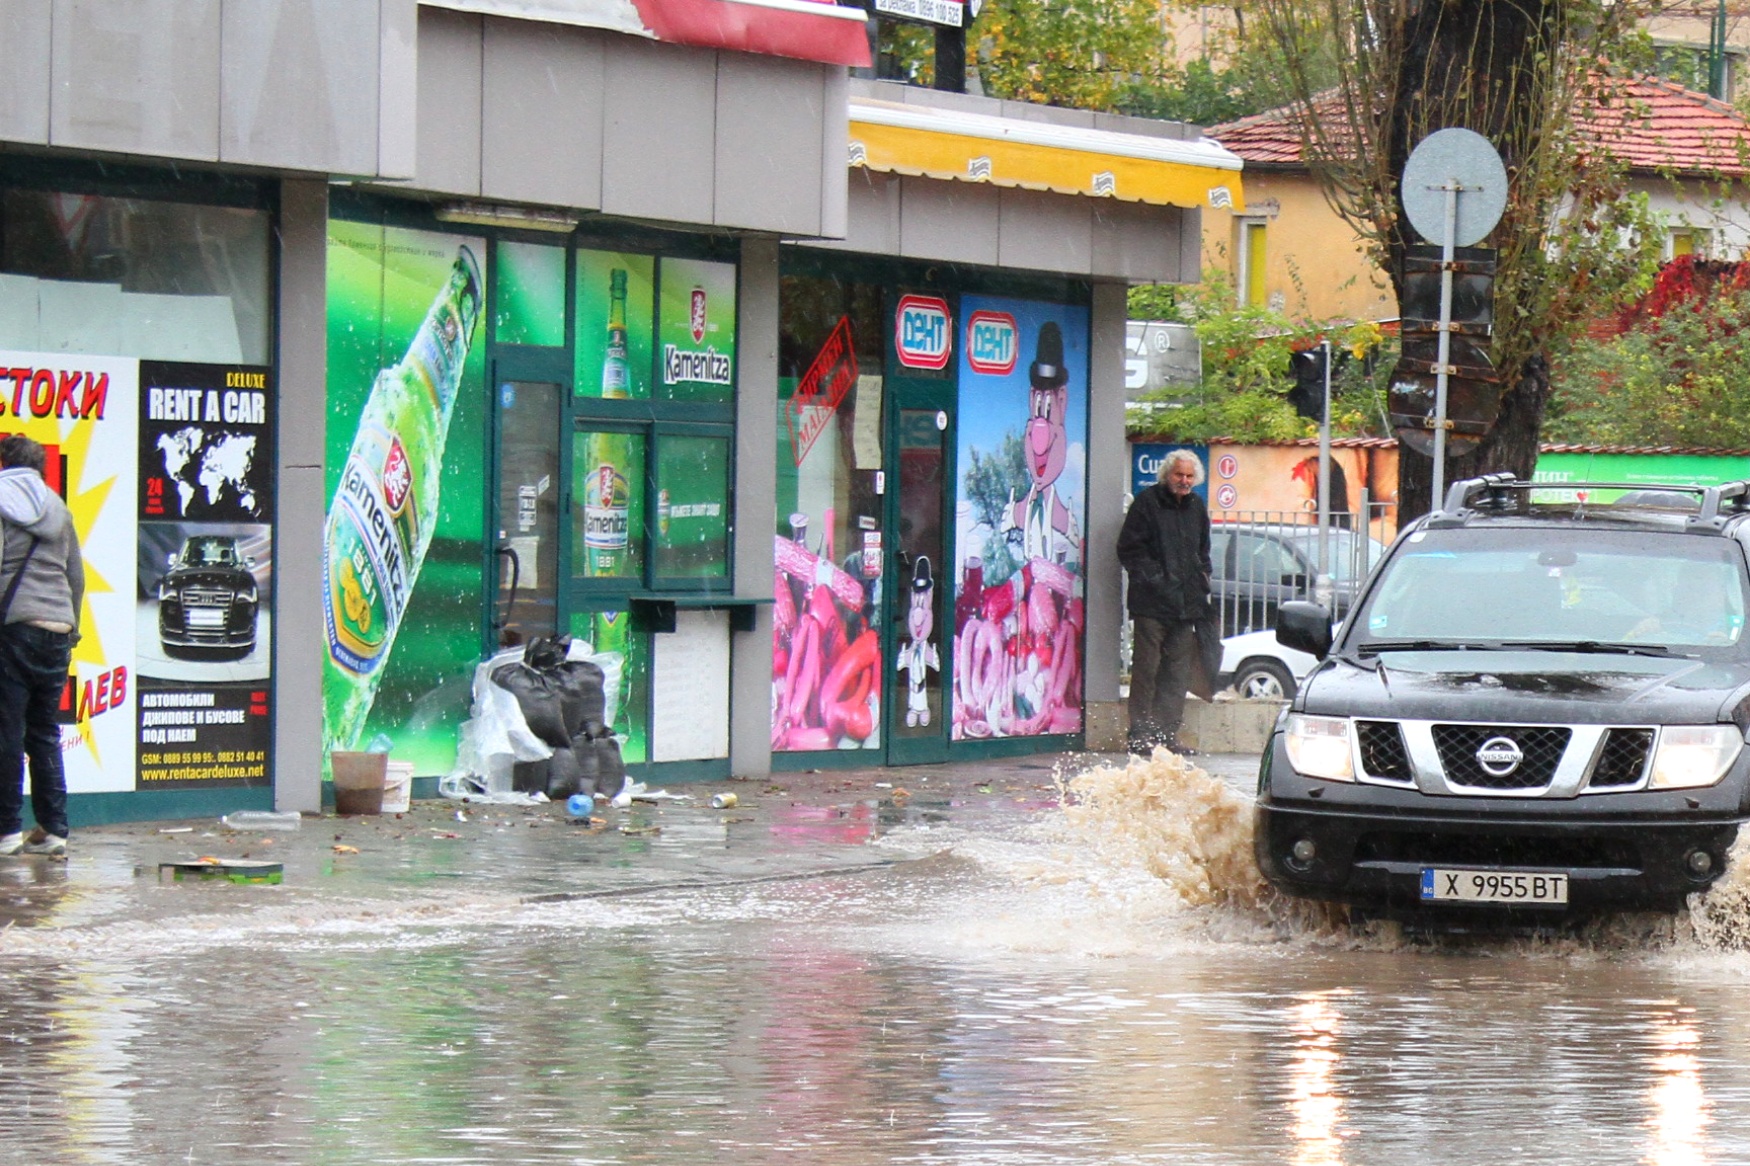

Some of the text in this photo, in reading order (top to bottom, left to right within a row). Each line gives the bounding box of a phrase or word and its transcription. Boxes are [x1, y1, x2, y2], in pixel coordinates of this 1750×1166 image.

[664, 344, 731, 384] Kamenitza
[226, 372, 266, 389] DELUXE
[149, 388, 266, 424] RENT A CAR
[147, 477, 163, 496] 24
[596, 556, 615, 567] 1881
[347, 538, 377, 607] 1881
[77, 665, 128, 724] ЛЕВ
[142, 693, 215, 708] АВТОМОБИЛИ
[142, 710, 195, 727] ДЖИПОВЕ
[196, 710, 204, 724] И
[205, 709, 245, 724] БУСОВЕ
[142, 728, 197, 745] ПОД НАЕМ
[141, 753, 162, 765] GSM:
[163, 752, 180, 764] 0889
[182, 752, 191, 763] 55
[192, 752, 202, 763] 99
[217, 751, 234, 763] 0882
[236, 751, 244, 761] 51
[246, 751, 255, 761] 40
[255, 750, 264, 761] 41
[1480, 753, 1519, 761] NISSAN
[141, 764, 264, 781] www.rentacardeluxe.net
[1446, 873, 1563, 899] X 9955 BT
